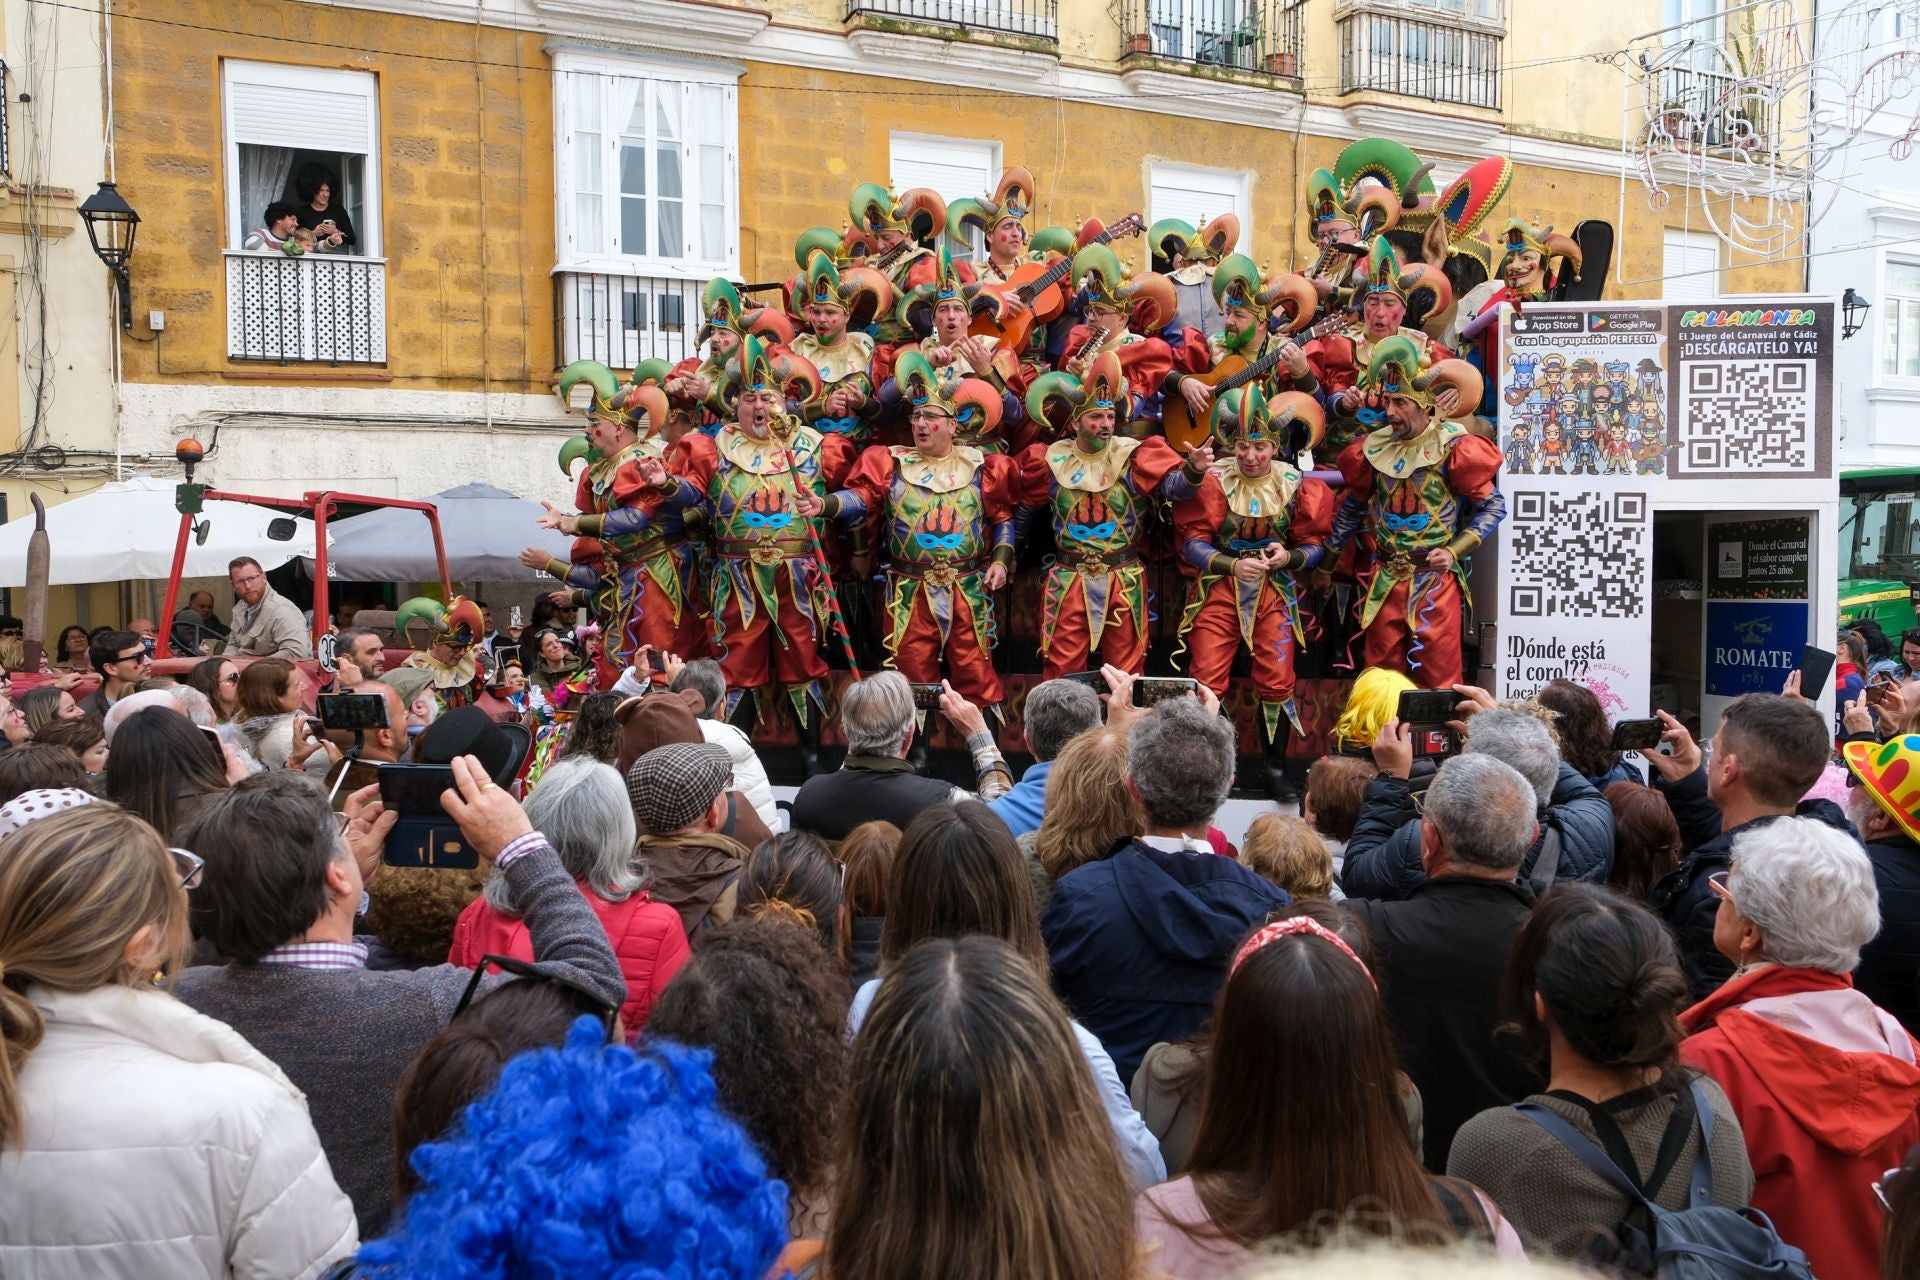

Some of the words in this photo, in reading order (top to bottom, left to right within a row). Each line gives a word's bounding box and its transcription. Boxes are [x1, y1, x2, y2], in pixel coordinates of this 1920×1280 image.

[1680, 310, 1815, 327] FALLAMANIA
[1532, 321, 1551, 331] App
[1553, 321, 1579, 329] Store
[1609, 322, 1637, 331] Google
[1639, 322, 1657, 330] Play
[1515, 336, 1536, 346] Crea
[1539, 336, 1549, 345] la
[1552, 335, 1607, 347] agrupación
[1609, 334, 1657, 344] PERFECTA
[1679, 332, 1687, 340] El
[1690, 332, 1717, 341] Juego
[1720, 331, 1734, 339] del
[1737, 331, 1777, 339] Carnaval
[1794, 330, 1817, 338] Cádiz
[1680, 341, 1789, 358] ¡DESCÁRGATELO
[1794, 341, 1818, 354] YA!
[1748, 540, 1769, 551] Donde
[1770, 540, 1776, 549] el
[1777, 538, 1806, 550] Carnaval
[1759, 553, 1778, 562] sabor
[1778, 551, 1808, 564] cumplen
[1747, 563, 1767, 577] juntos
[1768, 565, 1776, 574] 25
[1777, 564, 1794, 574] años
[1507, 635, 1566, 659] !Dónde
[1571, 639, 1605, 660] está
[1715, 648, 1793, 669] ROMATE
[1506, 659, 1521, 681] el
